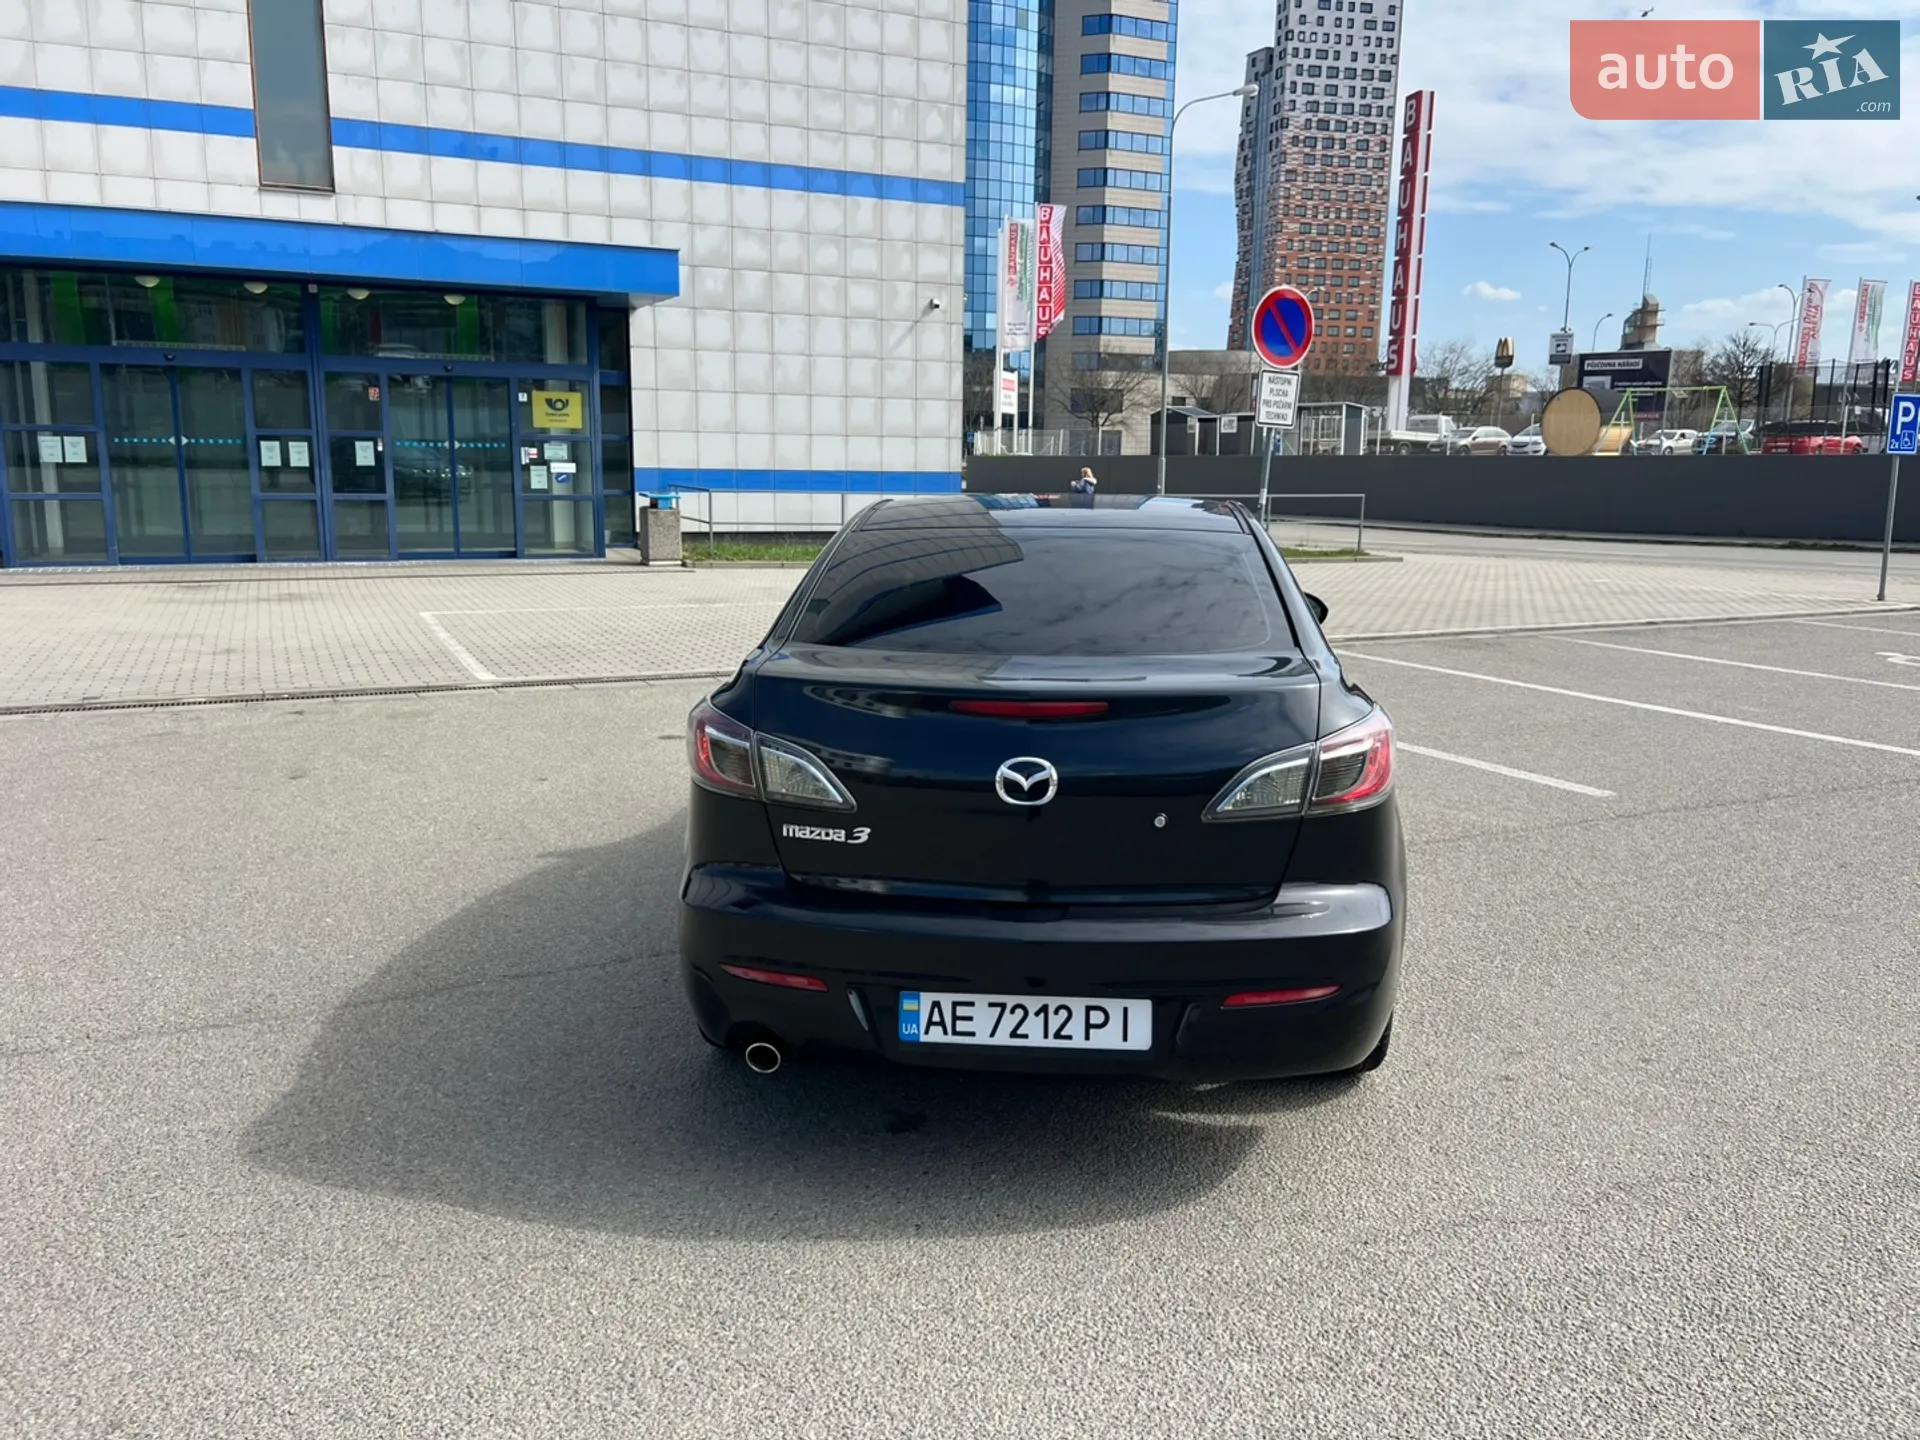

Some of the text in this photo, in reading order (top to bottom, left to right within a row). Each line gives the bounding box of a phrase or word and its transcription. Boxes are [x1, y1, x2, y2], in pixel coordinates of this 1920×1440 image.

[1388, 99, 1417, 370] BAUHAUS
[1037, 206, 1052, 336] BAUHAUS
[1896, 401, 1915, 435] P
[1890, 439, 1900, 449] 2x
[902, 1023, 919, 1036] UA
[924, 1001, 1129, 1042] AE 7212 PI
